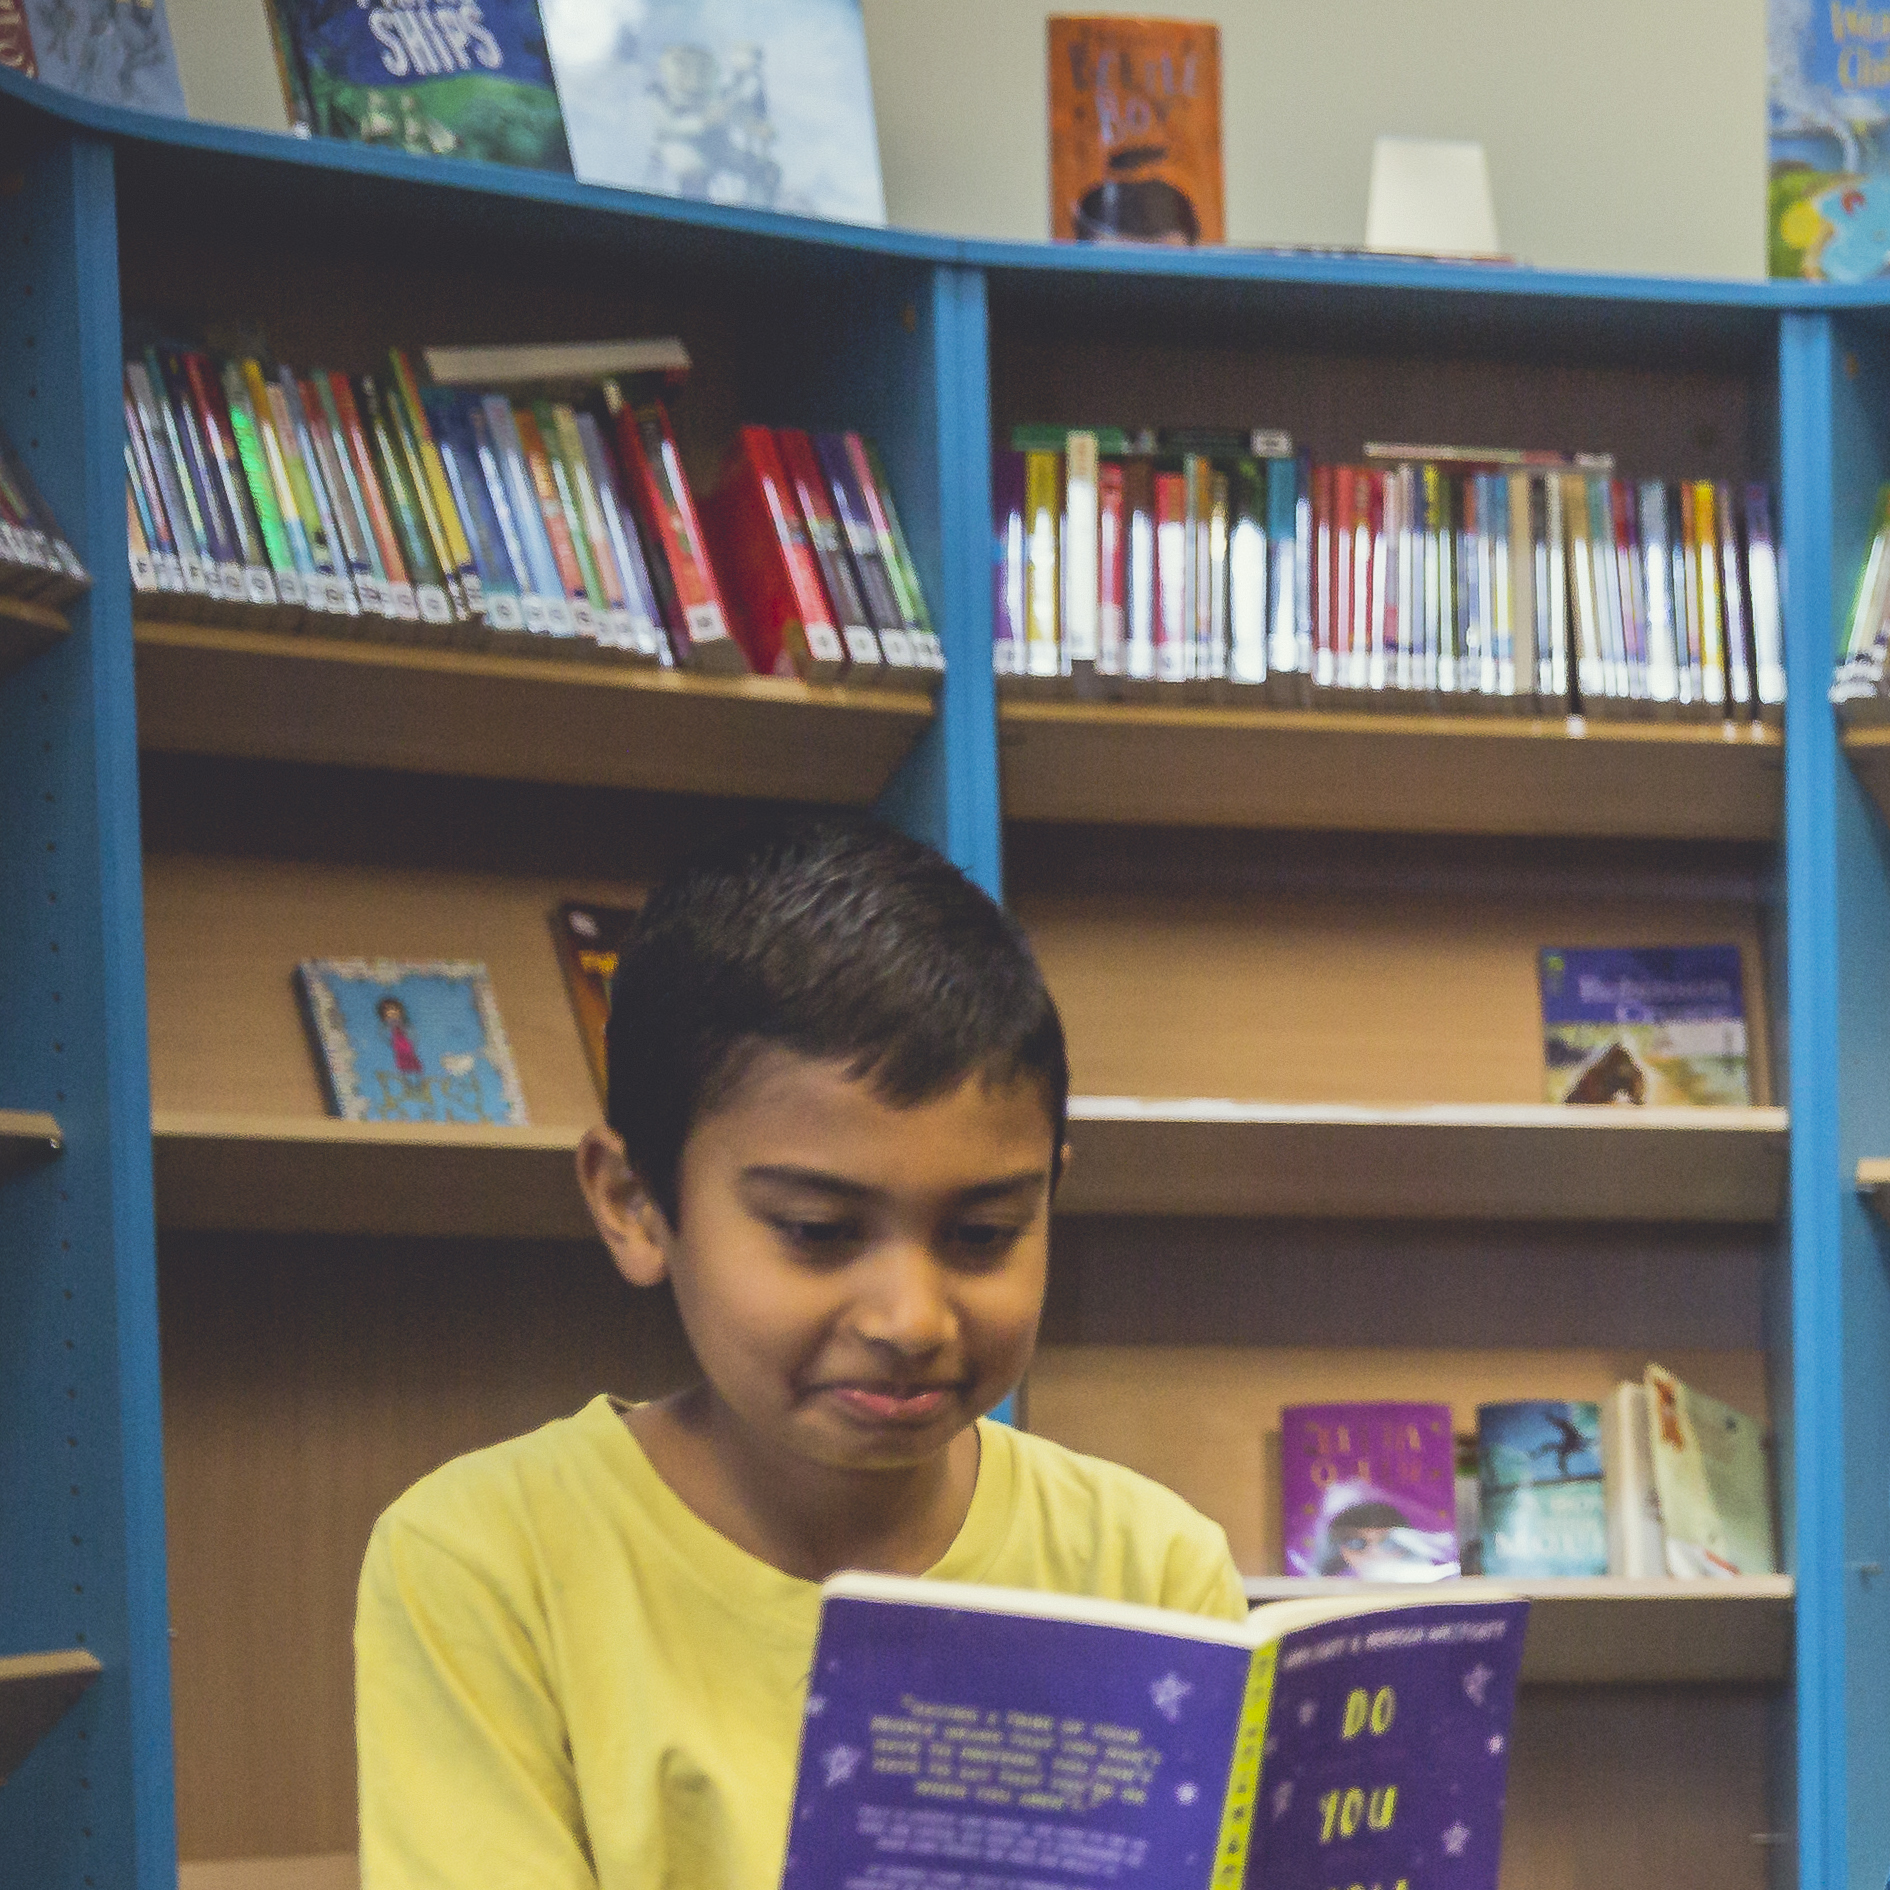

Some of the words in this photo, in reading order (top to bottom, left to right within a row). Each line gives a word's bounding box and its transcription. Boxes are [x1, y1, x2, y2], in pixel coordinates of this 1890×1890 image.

[369, 8, 502, 76] SHIPS
[1342, 1685, 1398, 1740] DO
[1320, 1784, 1399, 1844] YOU
